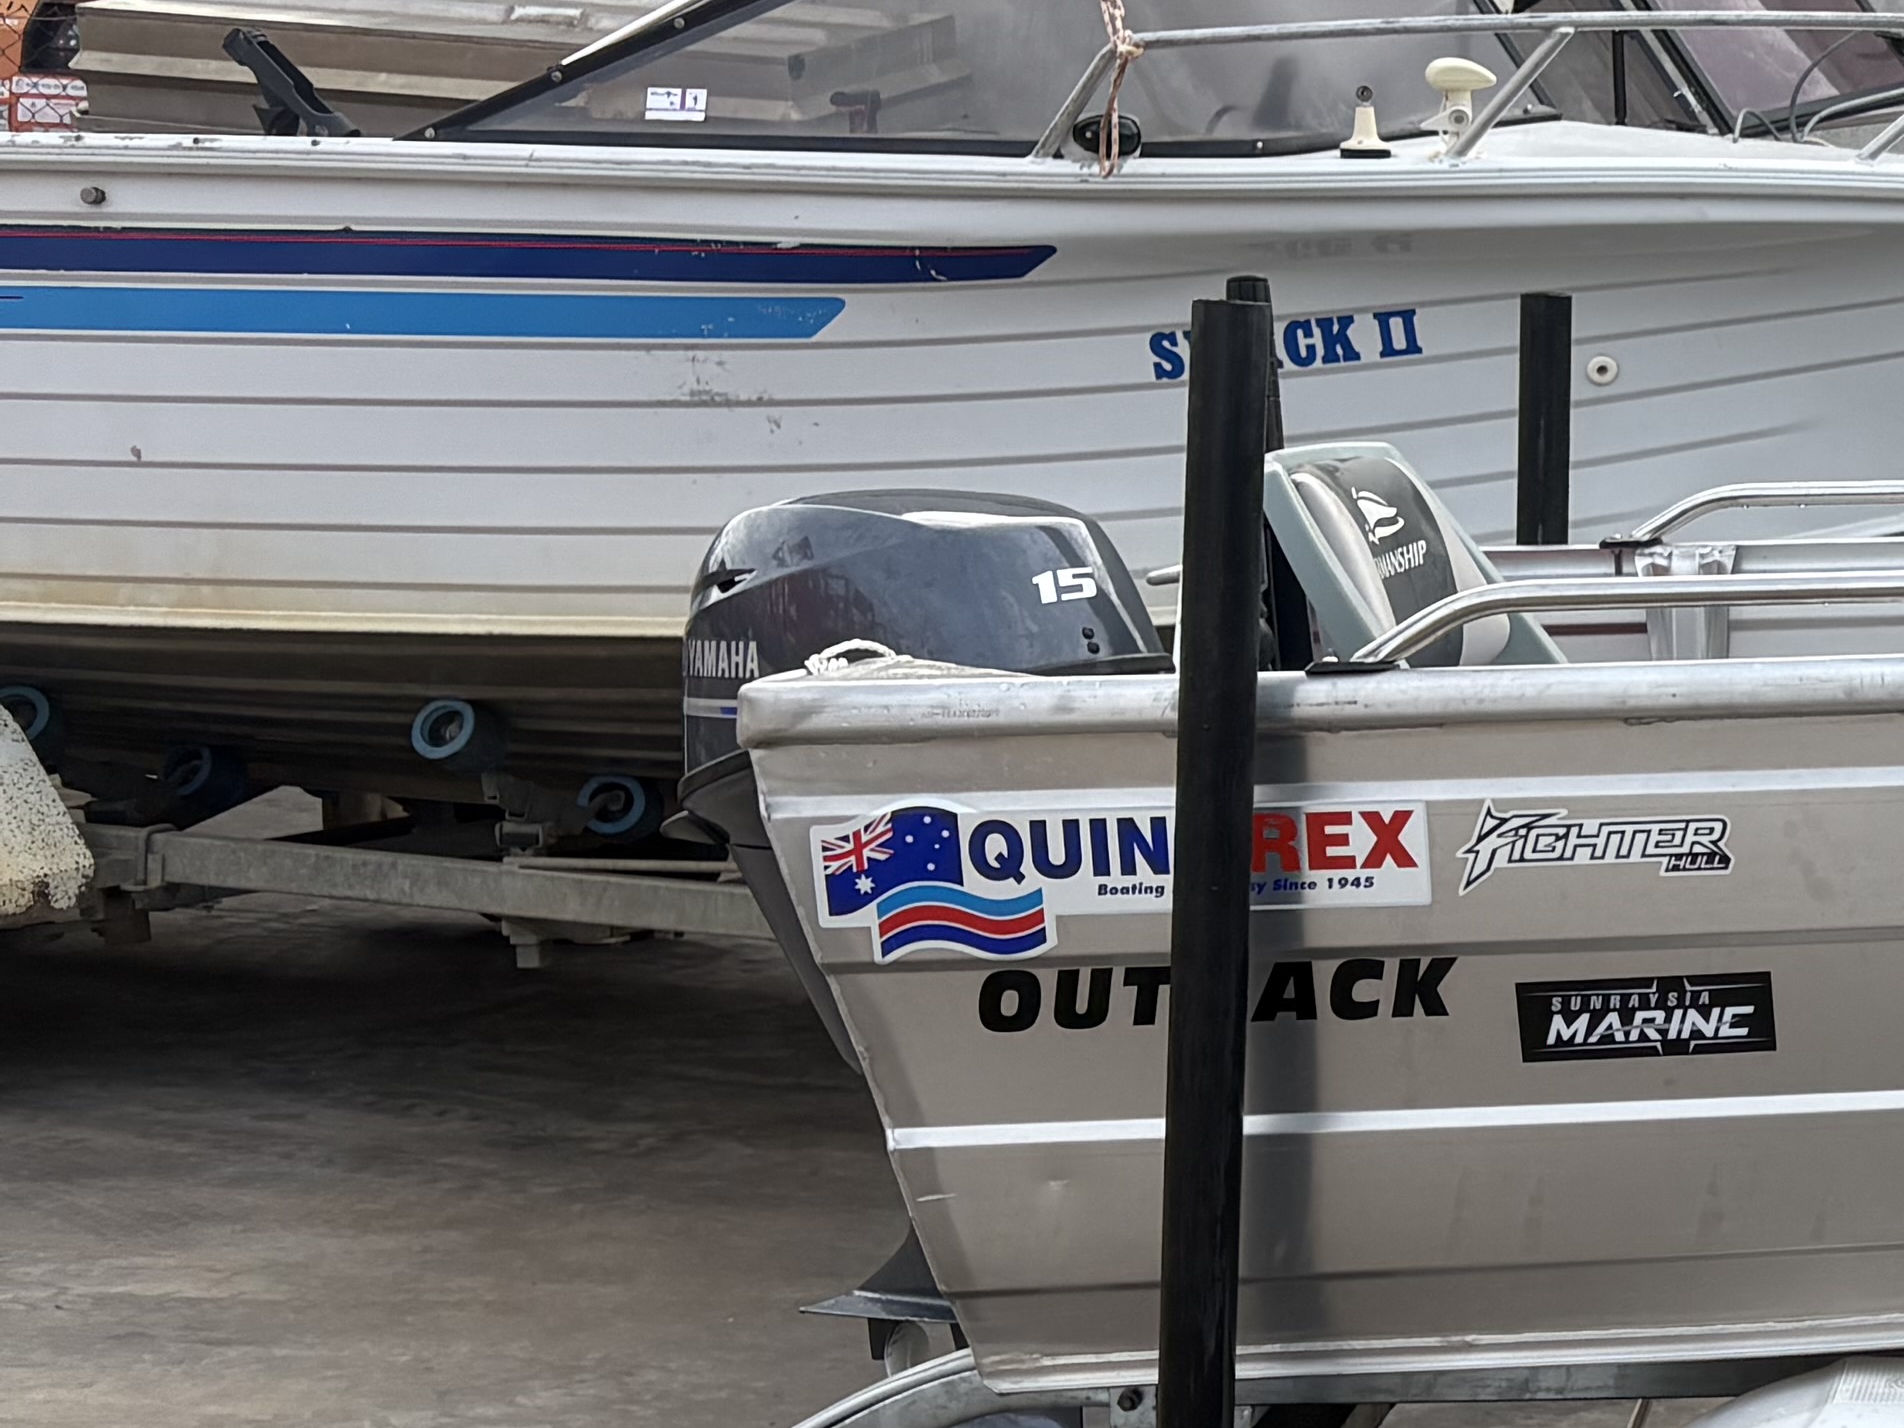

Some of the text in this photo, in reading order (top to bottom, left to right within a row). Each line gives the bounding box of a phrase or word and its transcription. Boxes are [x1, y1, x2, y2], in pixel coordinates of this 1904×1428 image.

[1149, 309, 1423, 380] SCK II
[1031, 566, 1098, 605] 15
[688, 639, 760, 679] YAMAHA
[967, 809, 1419, 886] QUINREX
[1668, 854, 1727, 870] HULL
[1097, 881, 1166, 899] Boating
[1327, 876, 1375, 890] 1945
[978, 957, 1458, 1033] OUTACK
[1551, 992, 1710, 1011] SUNRAYSIA
[1546, 1006, 1754, 1045] MARINE
